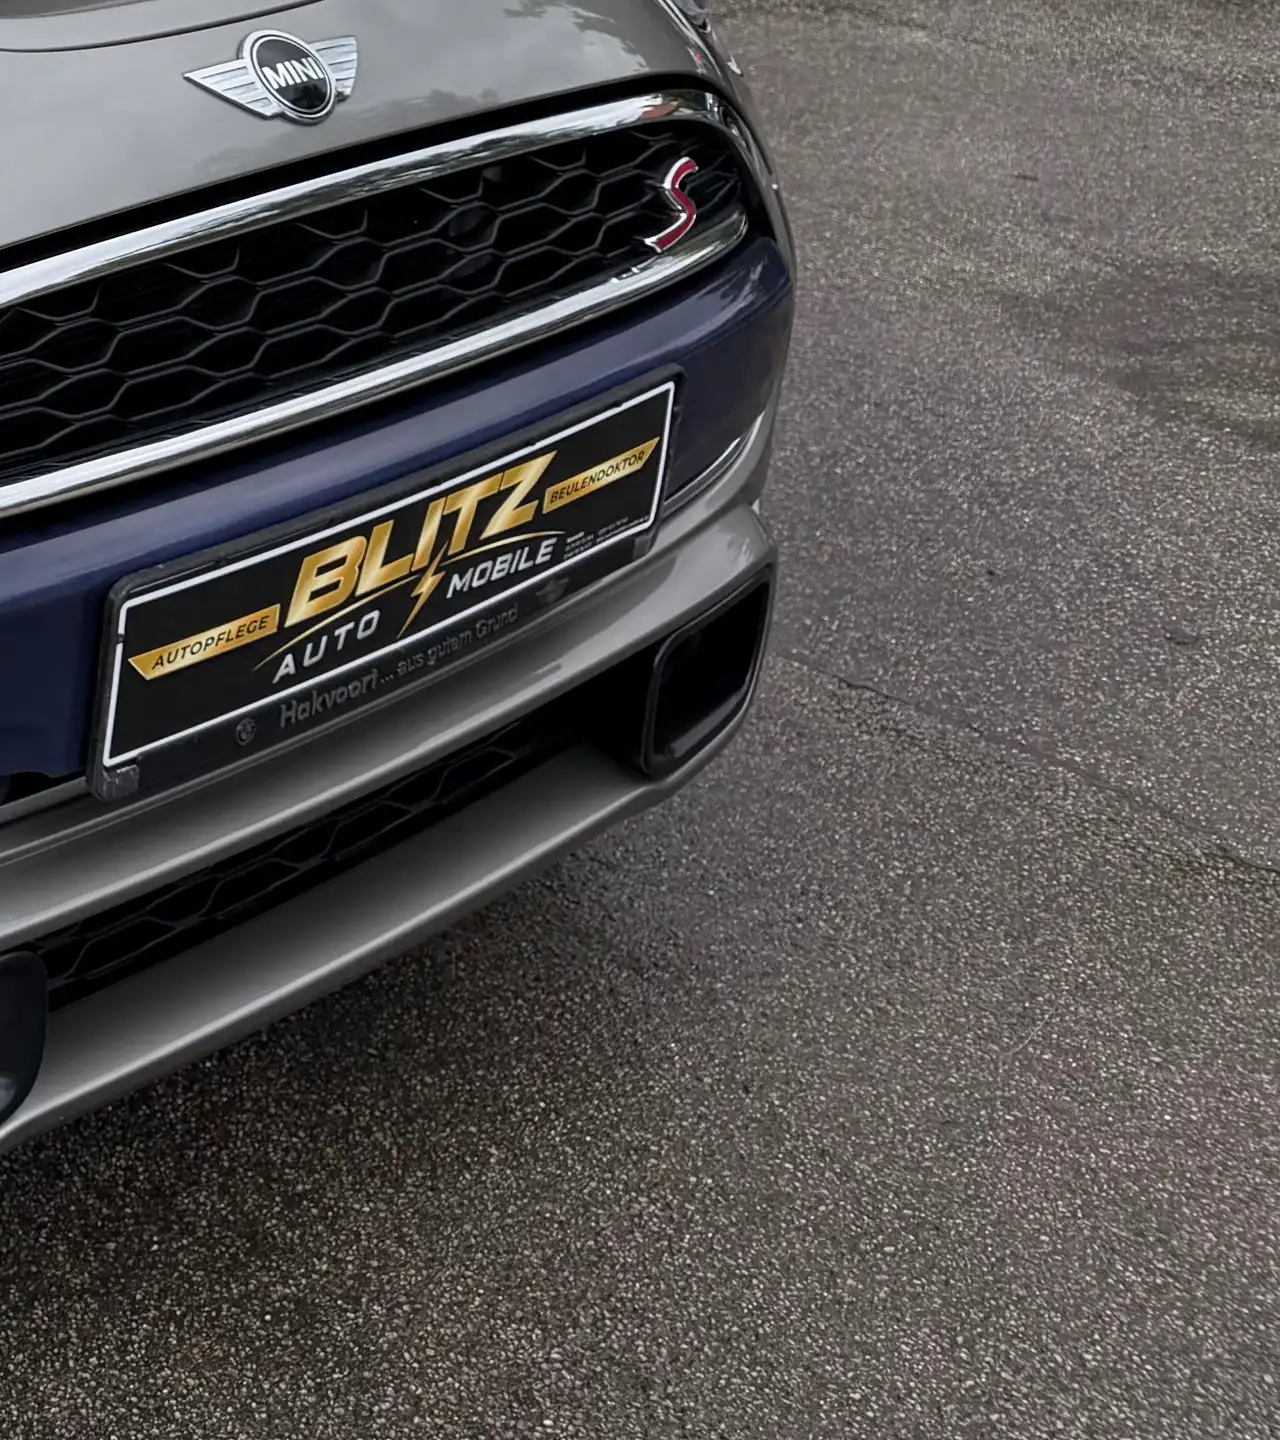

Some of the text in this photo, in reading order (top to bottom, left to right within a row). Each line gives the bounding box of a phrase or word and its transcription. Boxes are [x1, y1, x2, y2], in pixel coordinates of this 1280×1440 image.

[261, 56, 325, 90] MINI
[549, 450, 646, 505] BEULENDOKTOR
[284, 450, 558, 628] BLITZ
[272, 609, 381, 685] AUTO
[446, 537, 558, 600] MOBILE
[151, 615, 270, 671] AUTOPFLEGE
